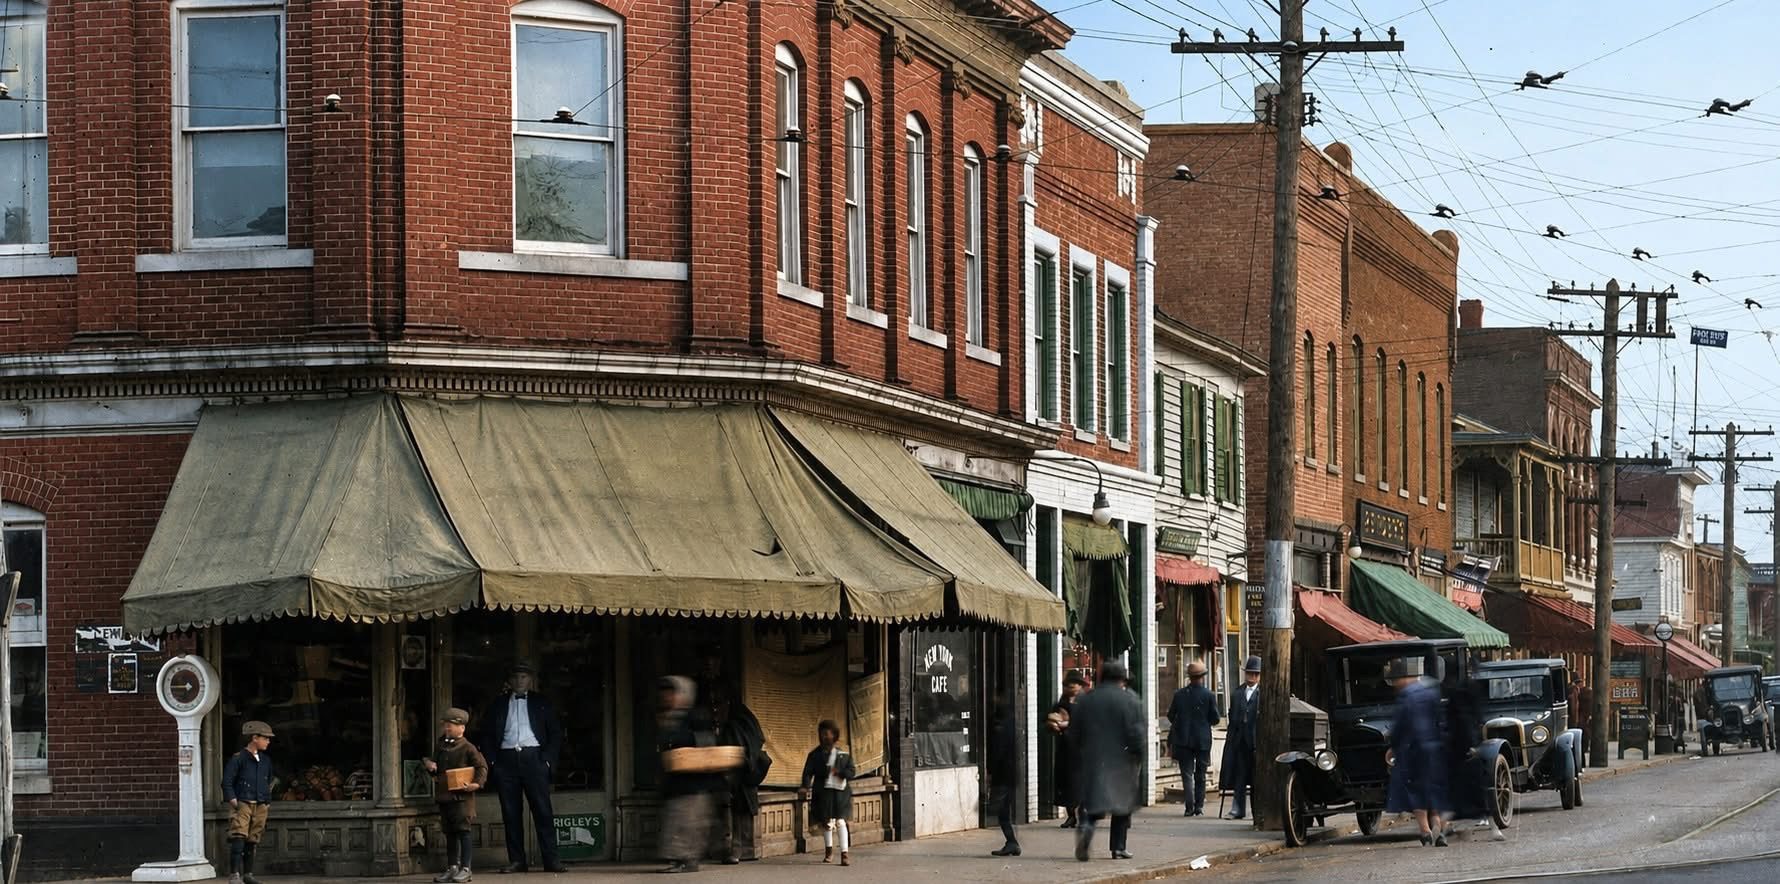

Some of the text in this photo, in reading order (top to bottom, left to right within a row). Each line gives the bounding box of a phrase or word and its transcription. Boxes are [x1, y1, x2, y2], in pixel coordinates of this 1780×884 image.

[924, 644, 937, 672] NEW
[931, 675, 948, 693] CAFE
[553, 816, 600, 828] RIGLEYS
